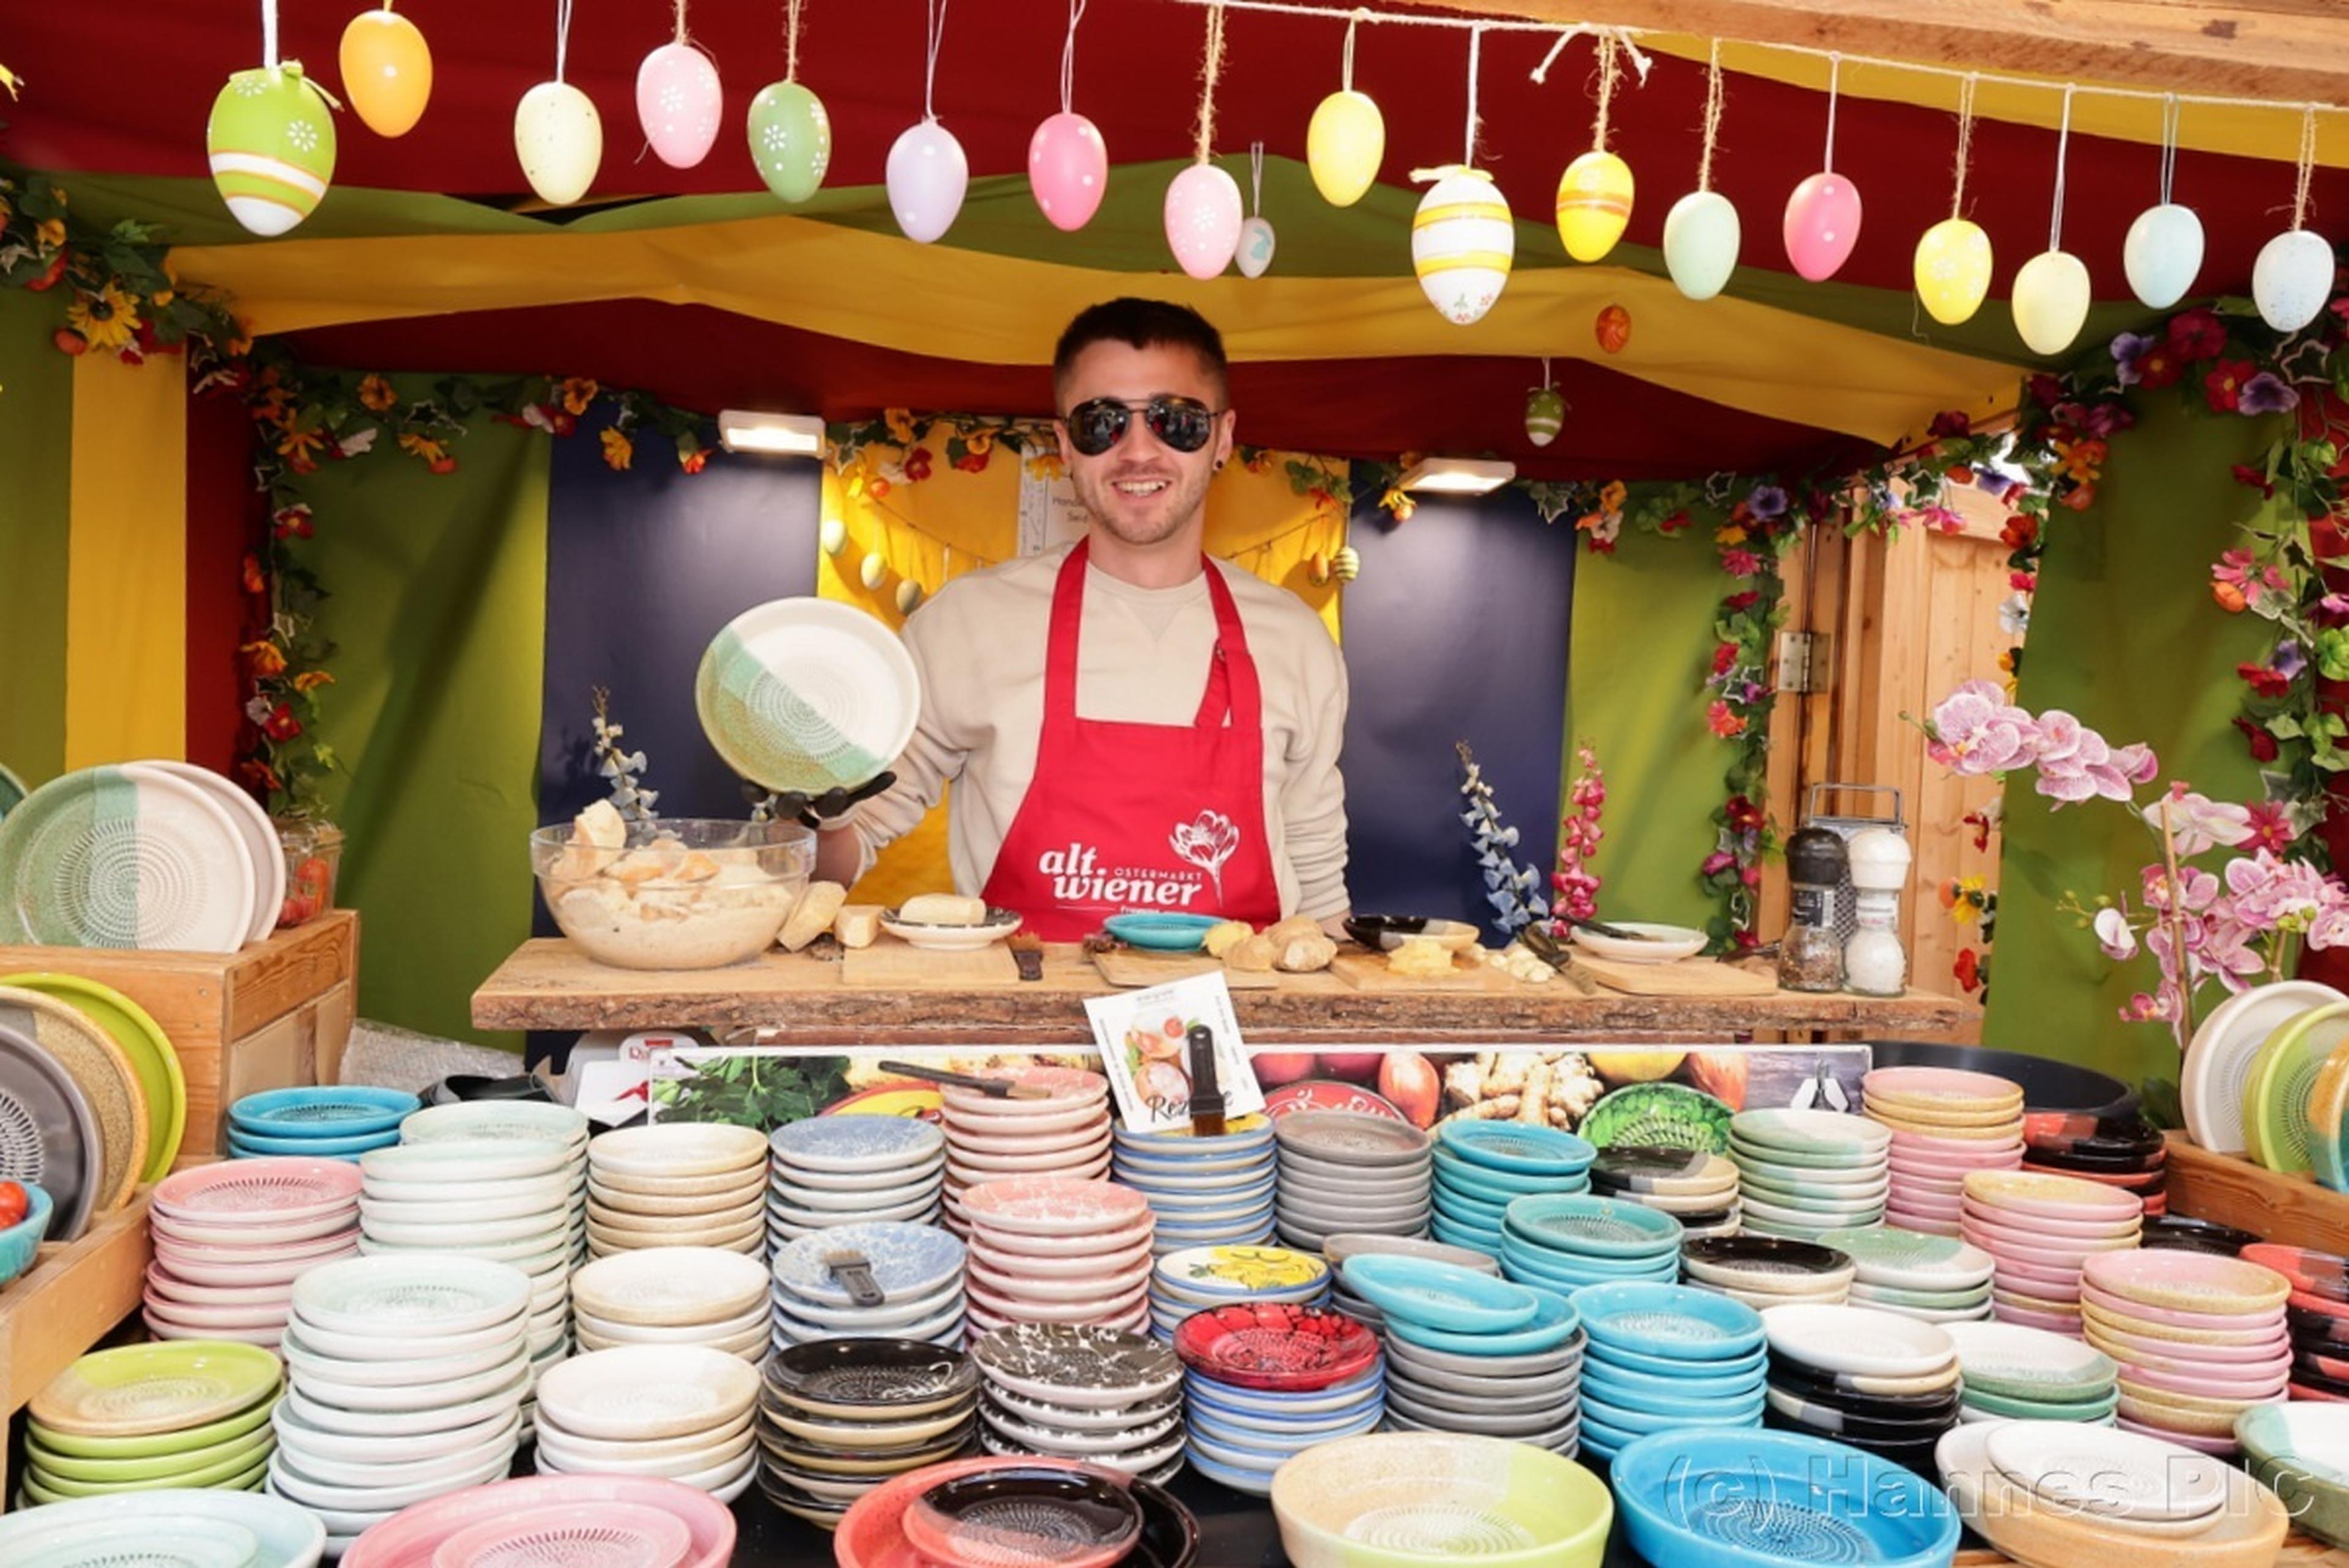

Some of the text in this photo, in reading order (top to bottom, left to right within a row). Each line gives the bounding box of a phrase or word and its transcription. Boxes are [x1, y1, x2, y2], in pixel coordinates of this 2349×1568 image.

[1039, 842, 1107, 876] alt.
[1113, 867, 1202, 881] OSTERMARKT
[1053, 875, 1203, 905] wiener
